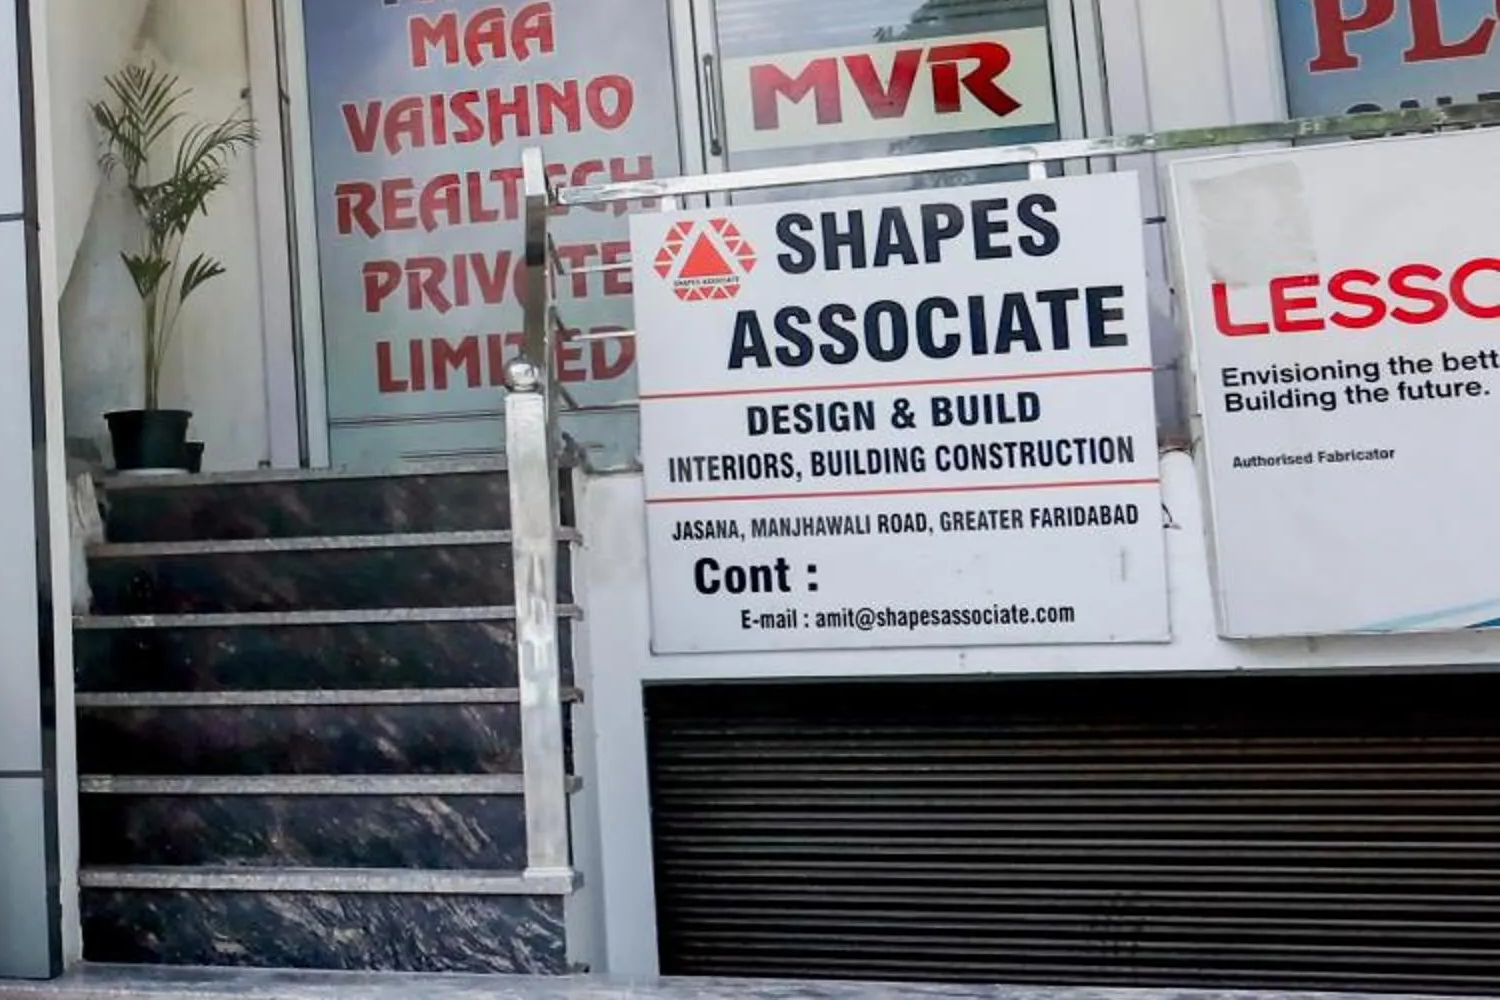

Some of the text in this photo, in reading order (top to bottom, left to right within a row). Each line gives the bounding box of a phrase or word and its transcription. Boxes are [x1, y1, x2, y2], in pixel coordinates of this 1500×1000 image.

[408, 1, 555, 68] MAA
[749, 42, 1022, 130] MVR
[341, 74, 634, 155] VAISHNO
[775, 194, 1060, 275] SHAPES
[362, 241, 633, 314] PRIVTE
[1211, 257, 1500, 337] LESSO
[728, 286, 1128, 370] ASSOCIATE
[1221, 359, 1380, 387] Envisioning
[1388, 354, 1433, 376] the
[747, 391, 1041, 436] DESIGN & BUILD
[1224, 379, 1491, 412] Building the future.
[669, 435, 1135, 483] INTERIORS, BUILDING CONSTRUCTION
[1232, 448, 1395, 469] Authorised Fabricator
[672, 503, 1139, 542] JASANA, MANJHAWALI ROAD, GREATER FARIDABAD
[694, 557, 791, 595] Cont
[741, 609, 797, 630] E-mail
[815, 603, 1075, 631] amit@shapesassociate.com
